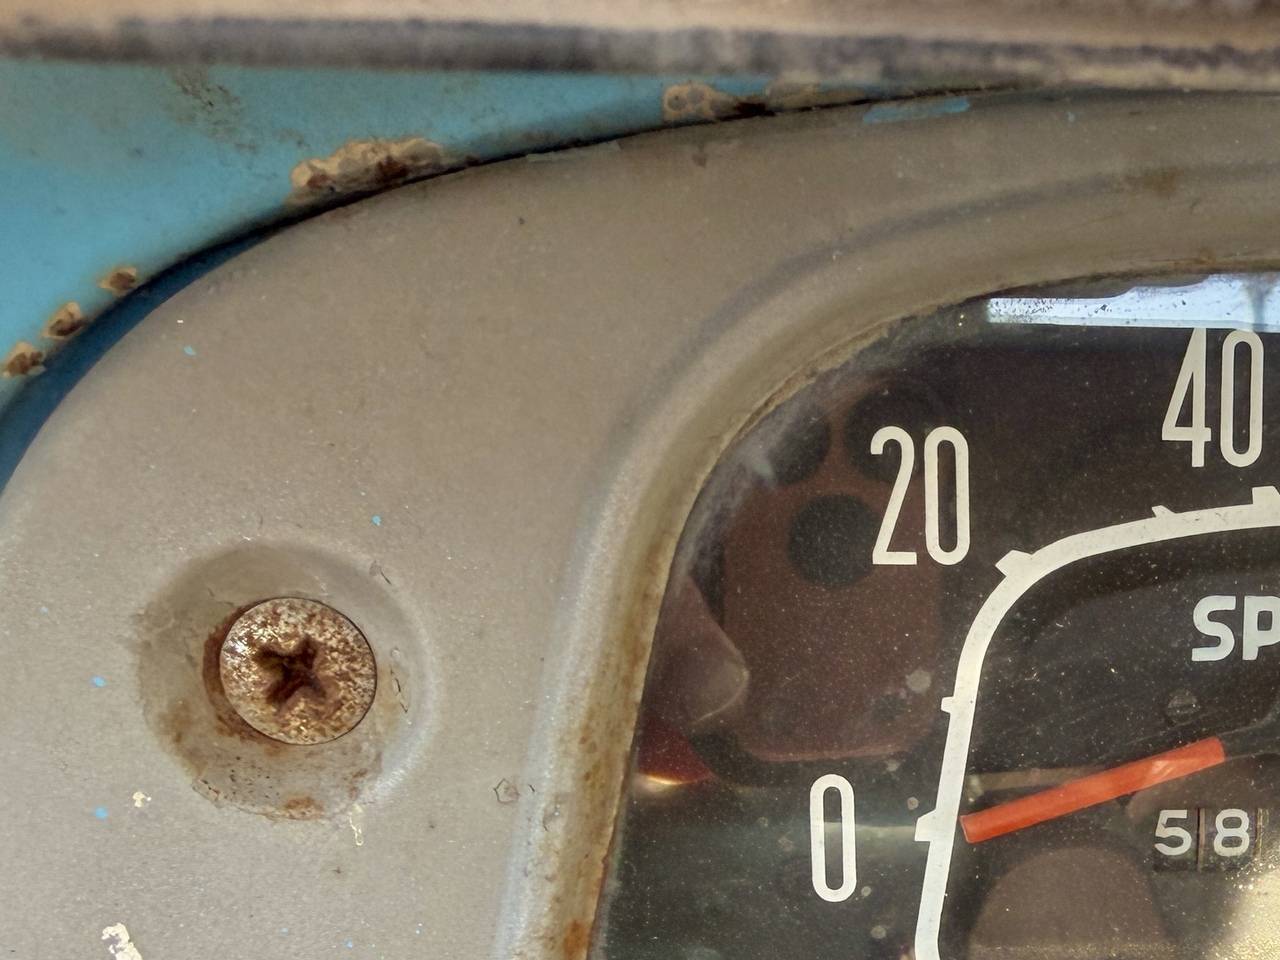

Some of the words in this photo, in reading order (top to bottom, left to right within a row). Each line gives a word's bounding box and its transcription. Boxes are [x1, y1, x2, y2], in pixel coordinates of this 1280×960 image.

[1161, 327, 1265, 468] 40
[870, 425, 971, 566] 20
[809, 774, 857, 903] 0
